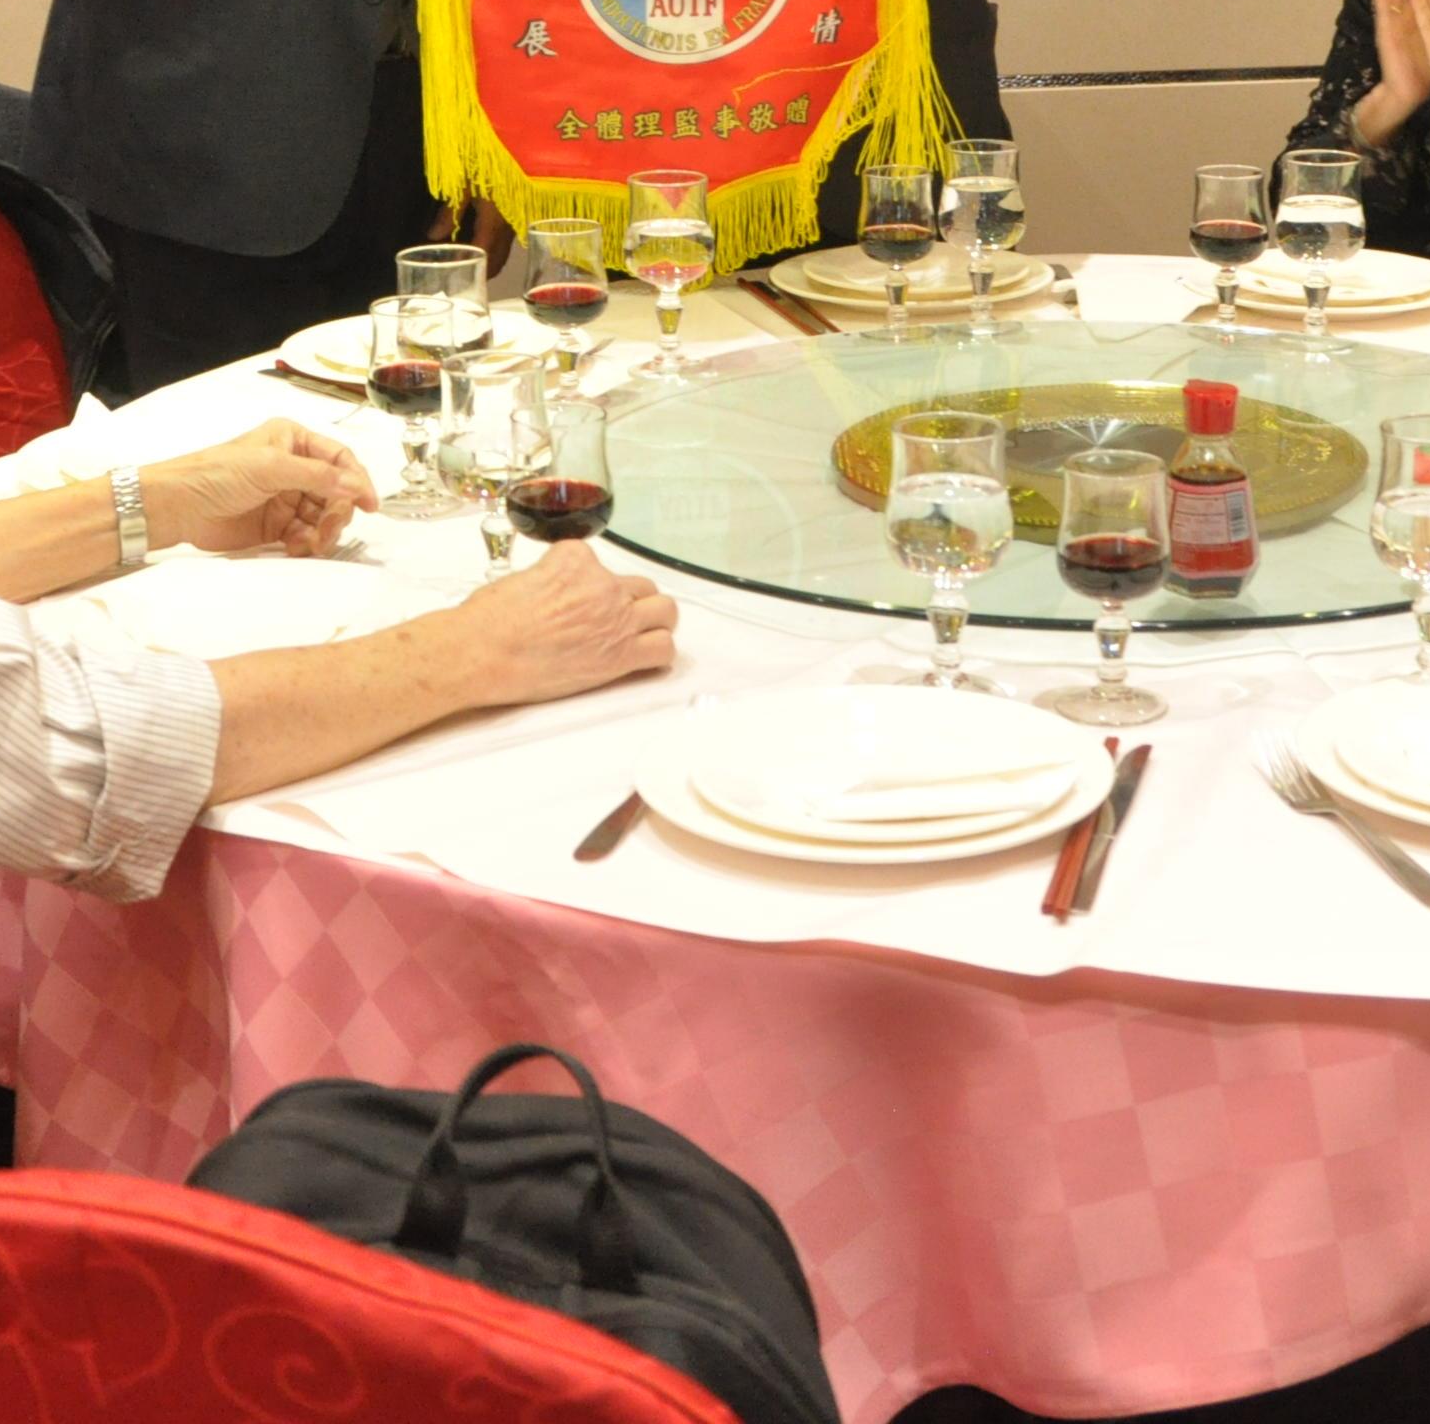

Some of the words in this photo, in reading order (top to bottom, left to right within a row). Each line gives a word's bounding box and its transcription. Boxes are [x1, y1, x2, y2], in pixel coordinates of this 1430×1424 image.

[704, 25, 731, 47] EN
[555, 93, 811, 140] 全體理監事敬贈
